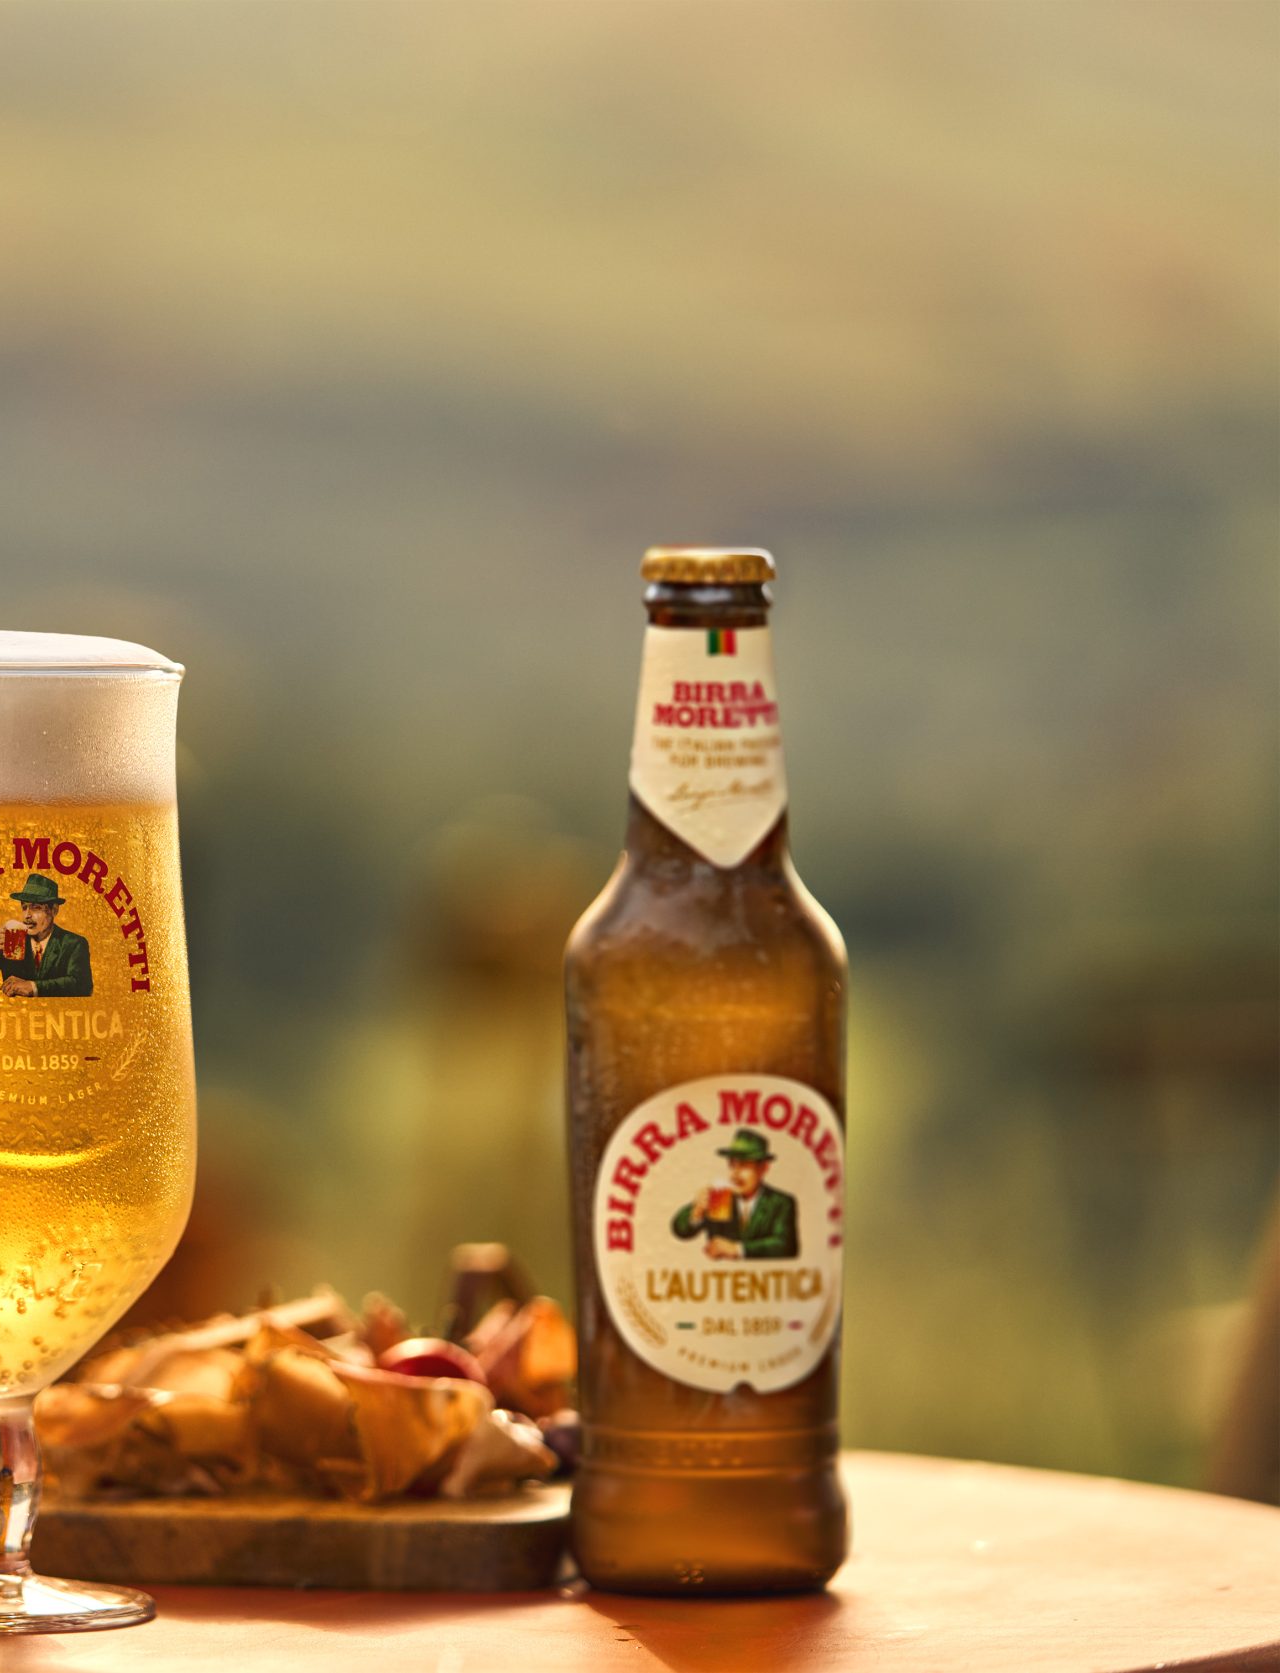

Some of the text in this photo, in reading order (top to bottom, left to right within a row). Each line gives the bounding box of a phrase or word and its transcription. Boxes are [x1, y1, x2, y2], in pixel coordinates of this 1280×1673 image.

[672, 681, 767, 703] BIRRA
[12, 837, 151, 993] MORETTI
[1, 1055, 79, 1071] DAL 1859
[58, 1082, 102, 1105] LAGER
[606, 1101, 711, 1253] BIRRA
[646, 1268, 823, 1303] L'AUTENTICA
[701, 1317, 737, 1336] DAL
